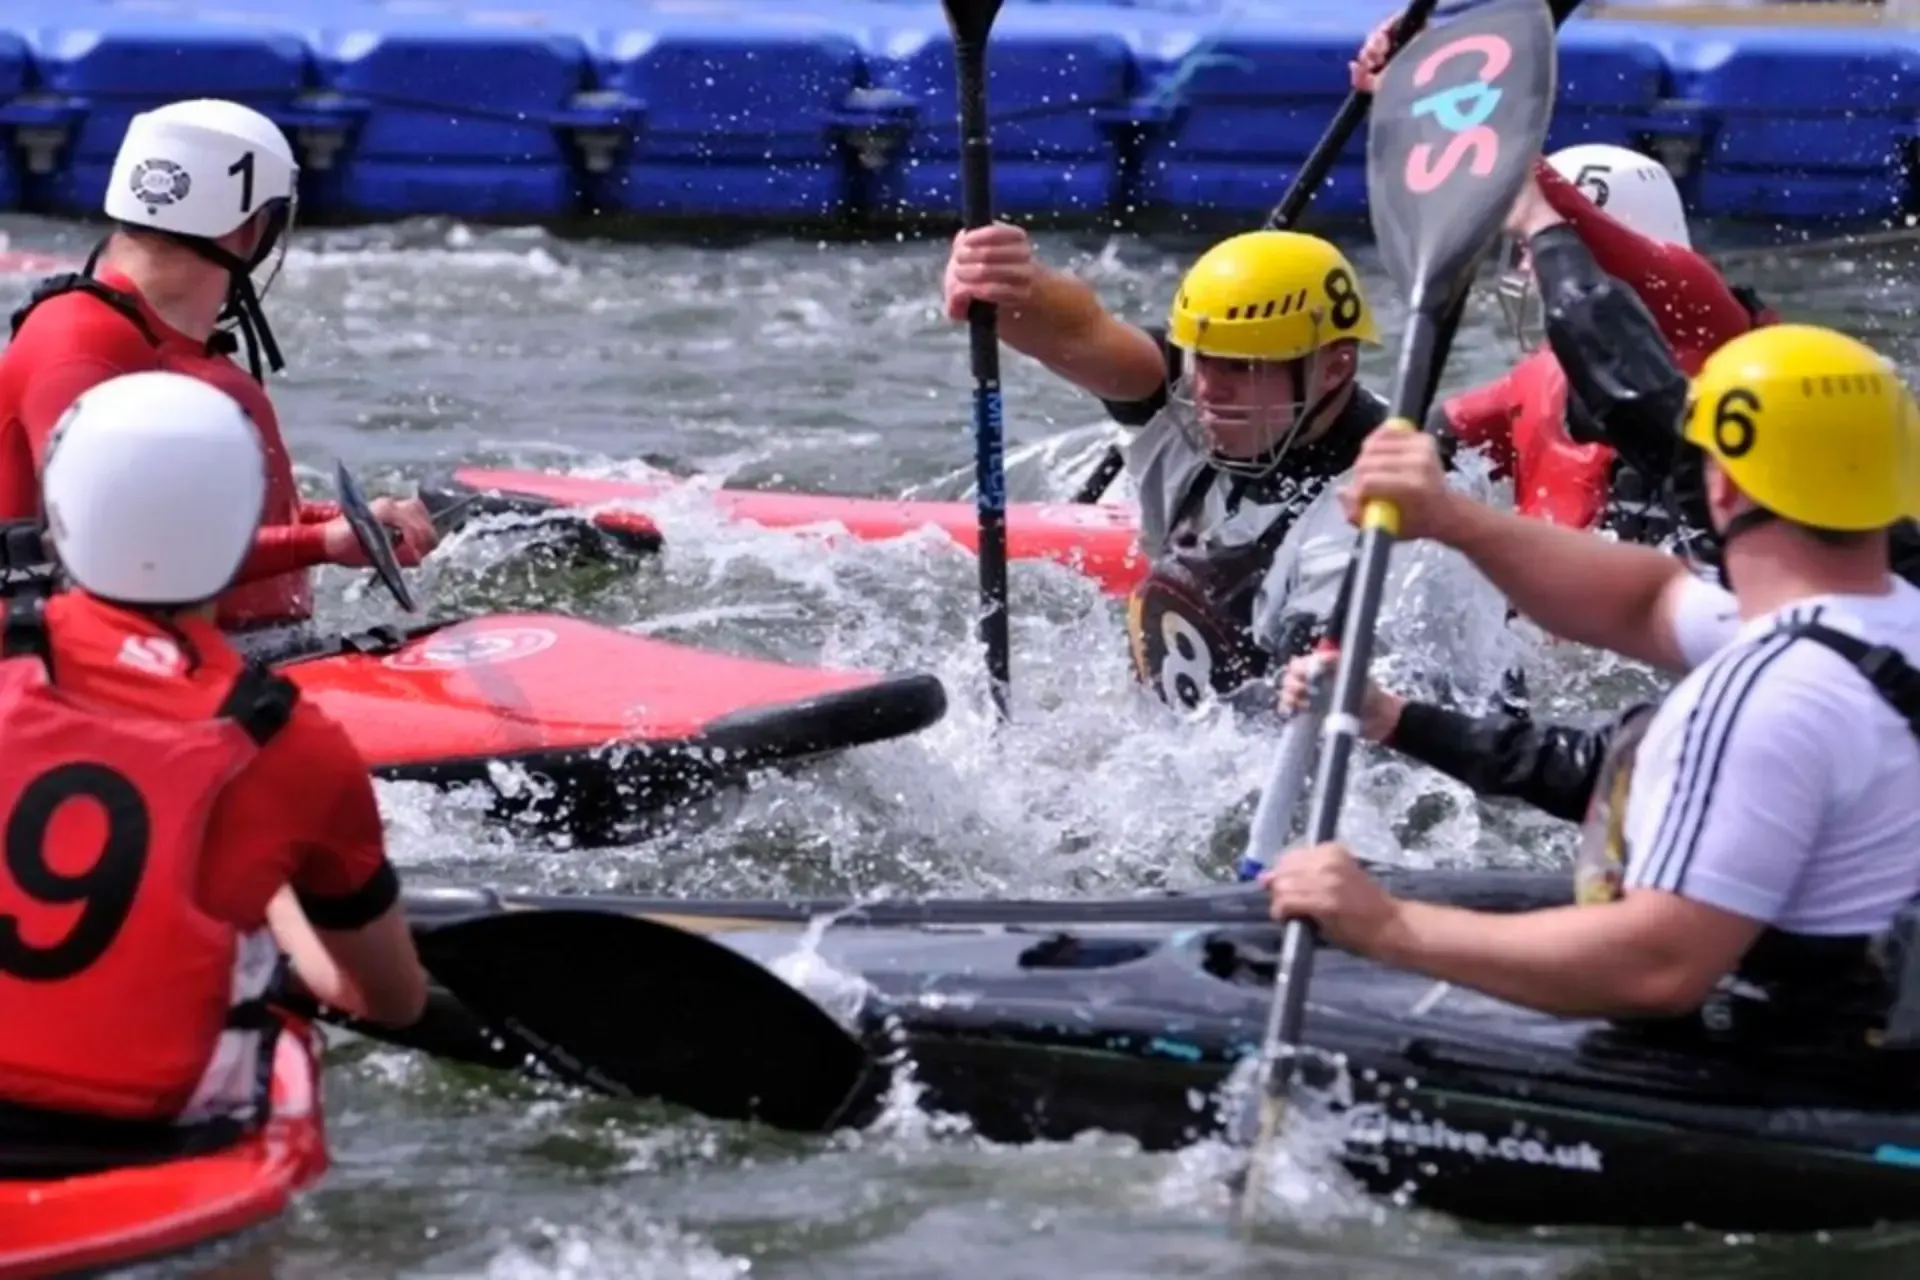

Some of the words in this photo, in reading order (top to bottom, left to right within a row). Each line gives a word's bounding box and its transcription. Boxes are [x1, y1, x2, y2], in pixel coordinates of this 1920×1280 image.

[1404, 34, 1512, 192] CPS
[228, 151, 254, 213] 1
[1576, 165, 1611, 208] 5
[1324, 269, 1361, 330] 8
[1714, 387, 1763, 458] 6
[1161, 610, 1212, 713] 8
[0, 760, 151, 981] 9
